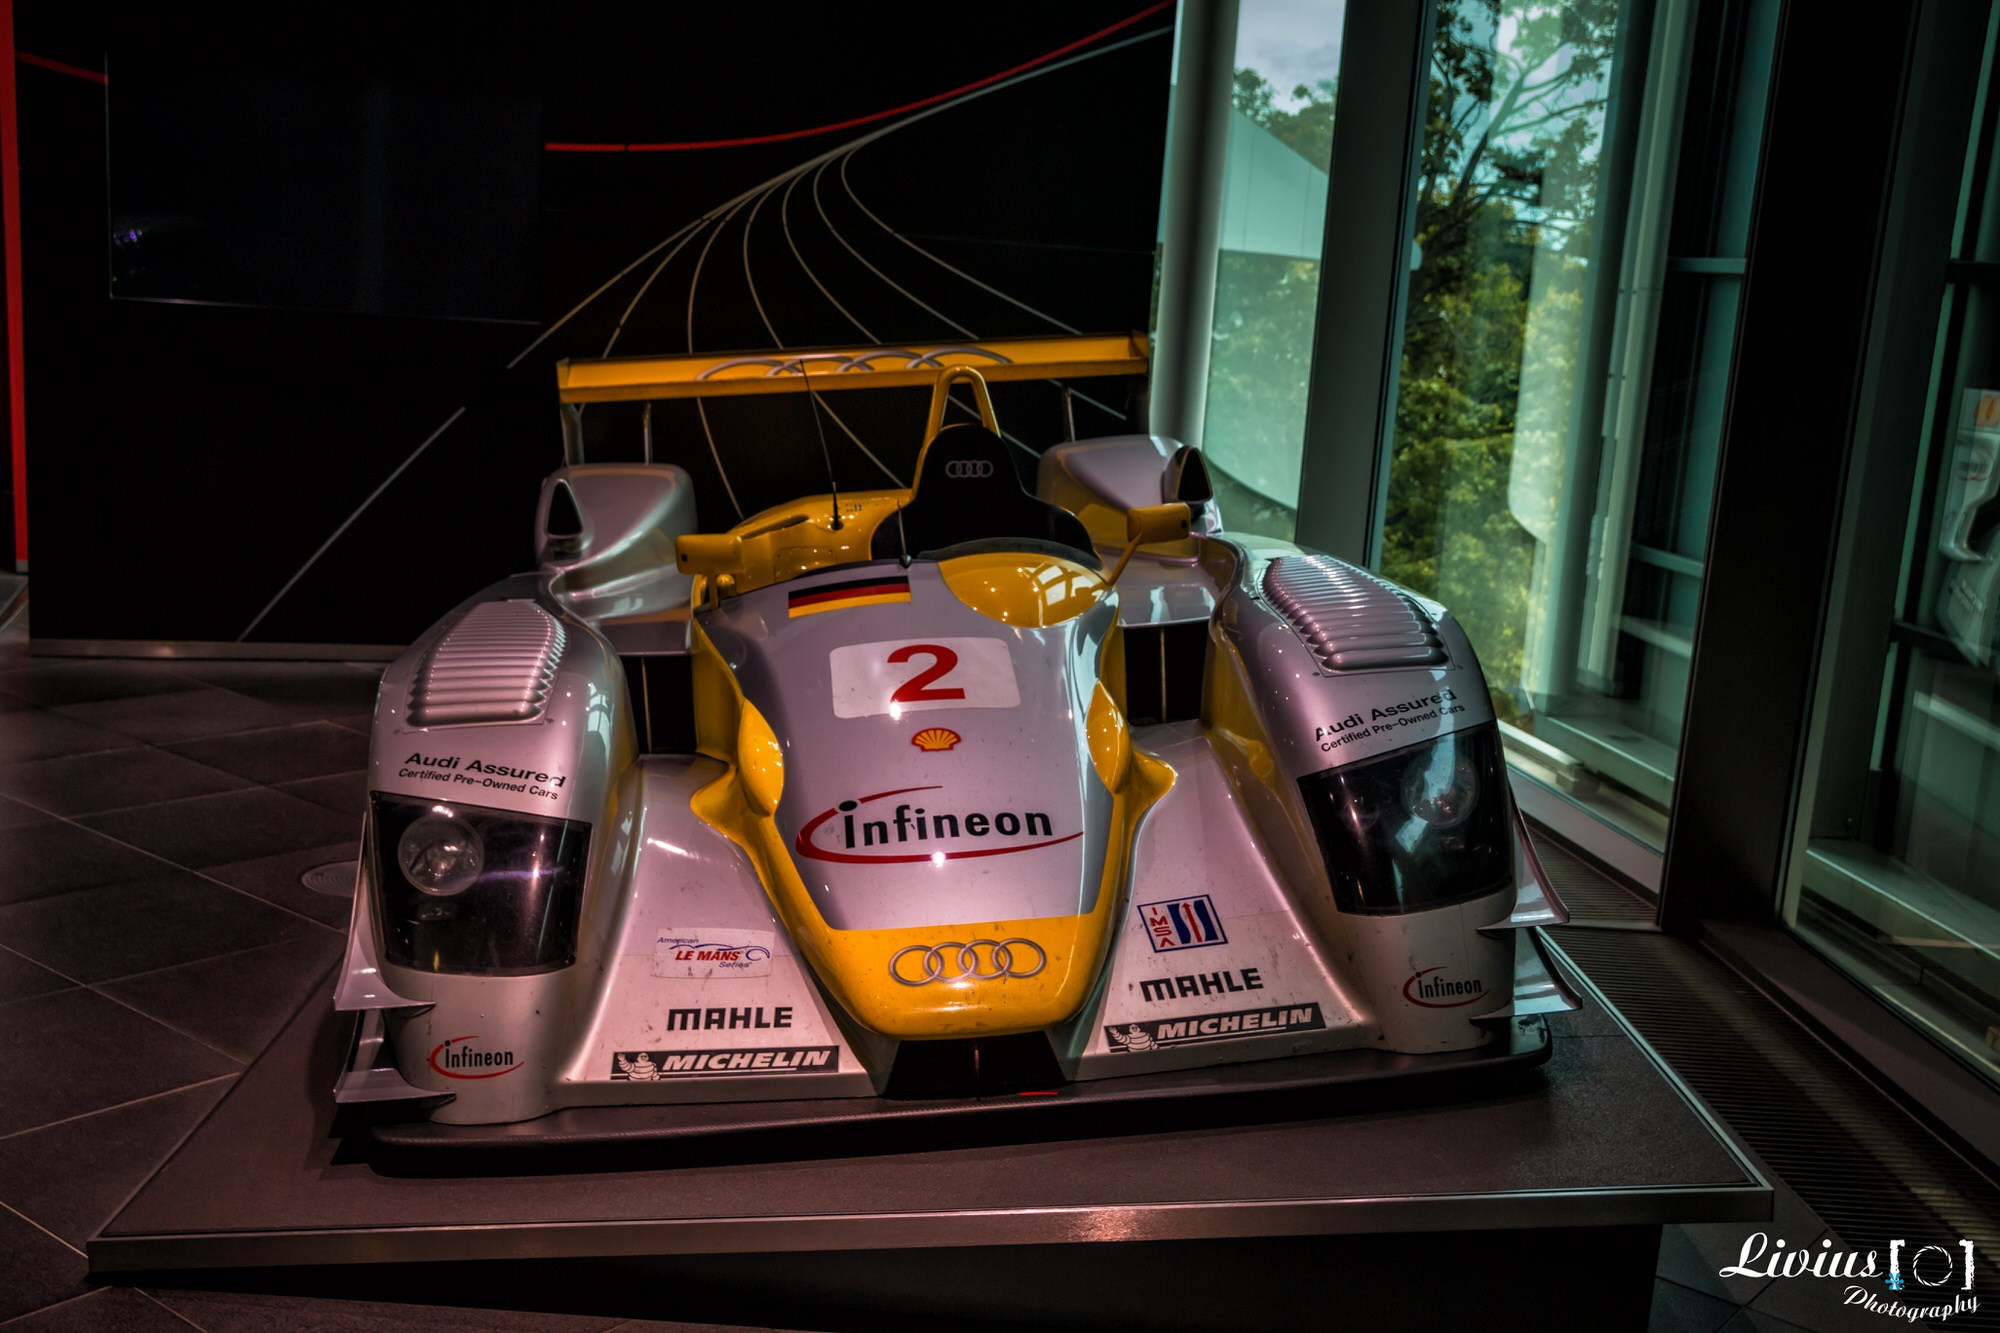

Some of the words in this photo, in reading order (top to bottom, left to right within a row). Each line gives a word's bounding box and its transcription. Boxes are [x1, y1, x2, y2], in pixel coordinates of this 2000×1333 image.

[887, 643, 966, 704] 2
[1315, 713, 1365, 742] Audi
[1371, 689, 1458, 722] Assured
[1321, 729, 1372, 752] Certified
[1373, 710, 1438, 735] Pre-Owned
[1438, 704, 1466, 716] Cars
[399, 768, 452, 782] Certified
[453, 773, 527, 793] Pre-Owned
[529, 785, 559, 800] Cars
[404, 753, 461, 769] Audi
[465, 760, 567, 788] Assured
[657, 936, 700, 944] American
[675, 950, 695, 961] LE
[696, 950, 742, 961] MANS
[1140, 968, 1264, 1001] MAHLE
[667, 1006, 793, 1031] MAHLE
[1157, 1007, 1313, 1040] MICHELIN
[662, 1050, 831, 1071] MICHELIN
